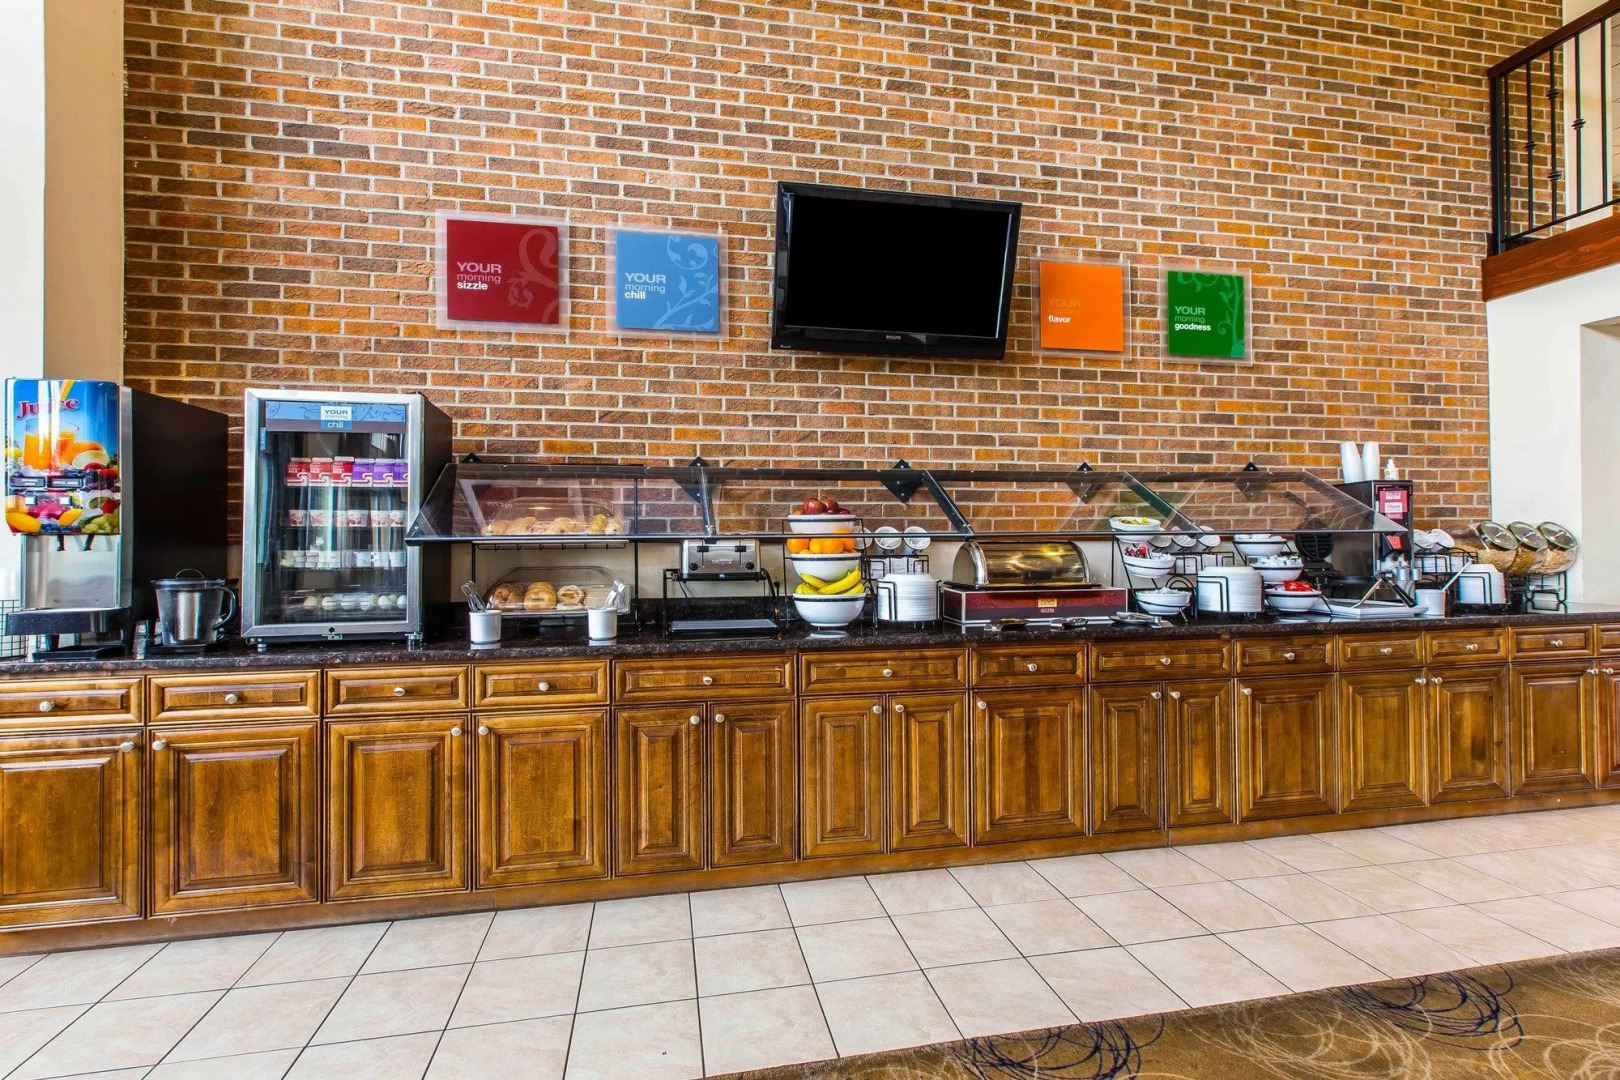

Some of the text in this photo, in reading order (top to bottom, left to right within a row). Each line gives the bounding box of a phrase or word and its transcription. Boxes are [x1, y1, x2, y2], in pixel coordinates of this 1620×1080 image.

[456, 262, 502, 274] YOUR
[456, 272, 501, 284] morning
[625, 272, 667, 284] YOUR
[456, 281, 488, 291] sizzle
[625, 283, 666, 294] morning
[625, 290, 646, 300] chill
[1048, 298, 1081, 308] YOUR
[1174, 306, 1206, 316] YOUR
[1048, 315, 1071, 323] flavor
[1174, 315, 1206, 324] morning
[1174, 323, 1212, 332] goodness
[16, 398, 80, 419] Jue
